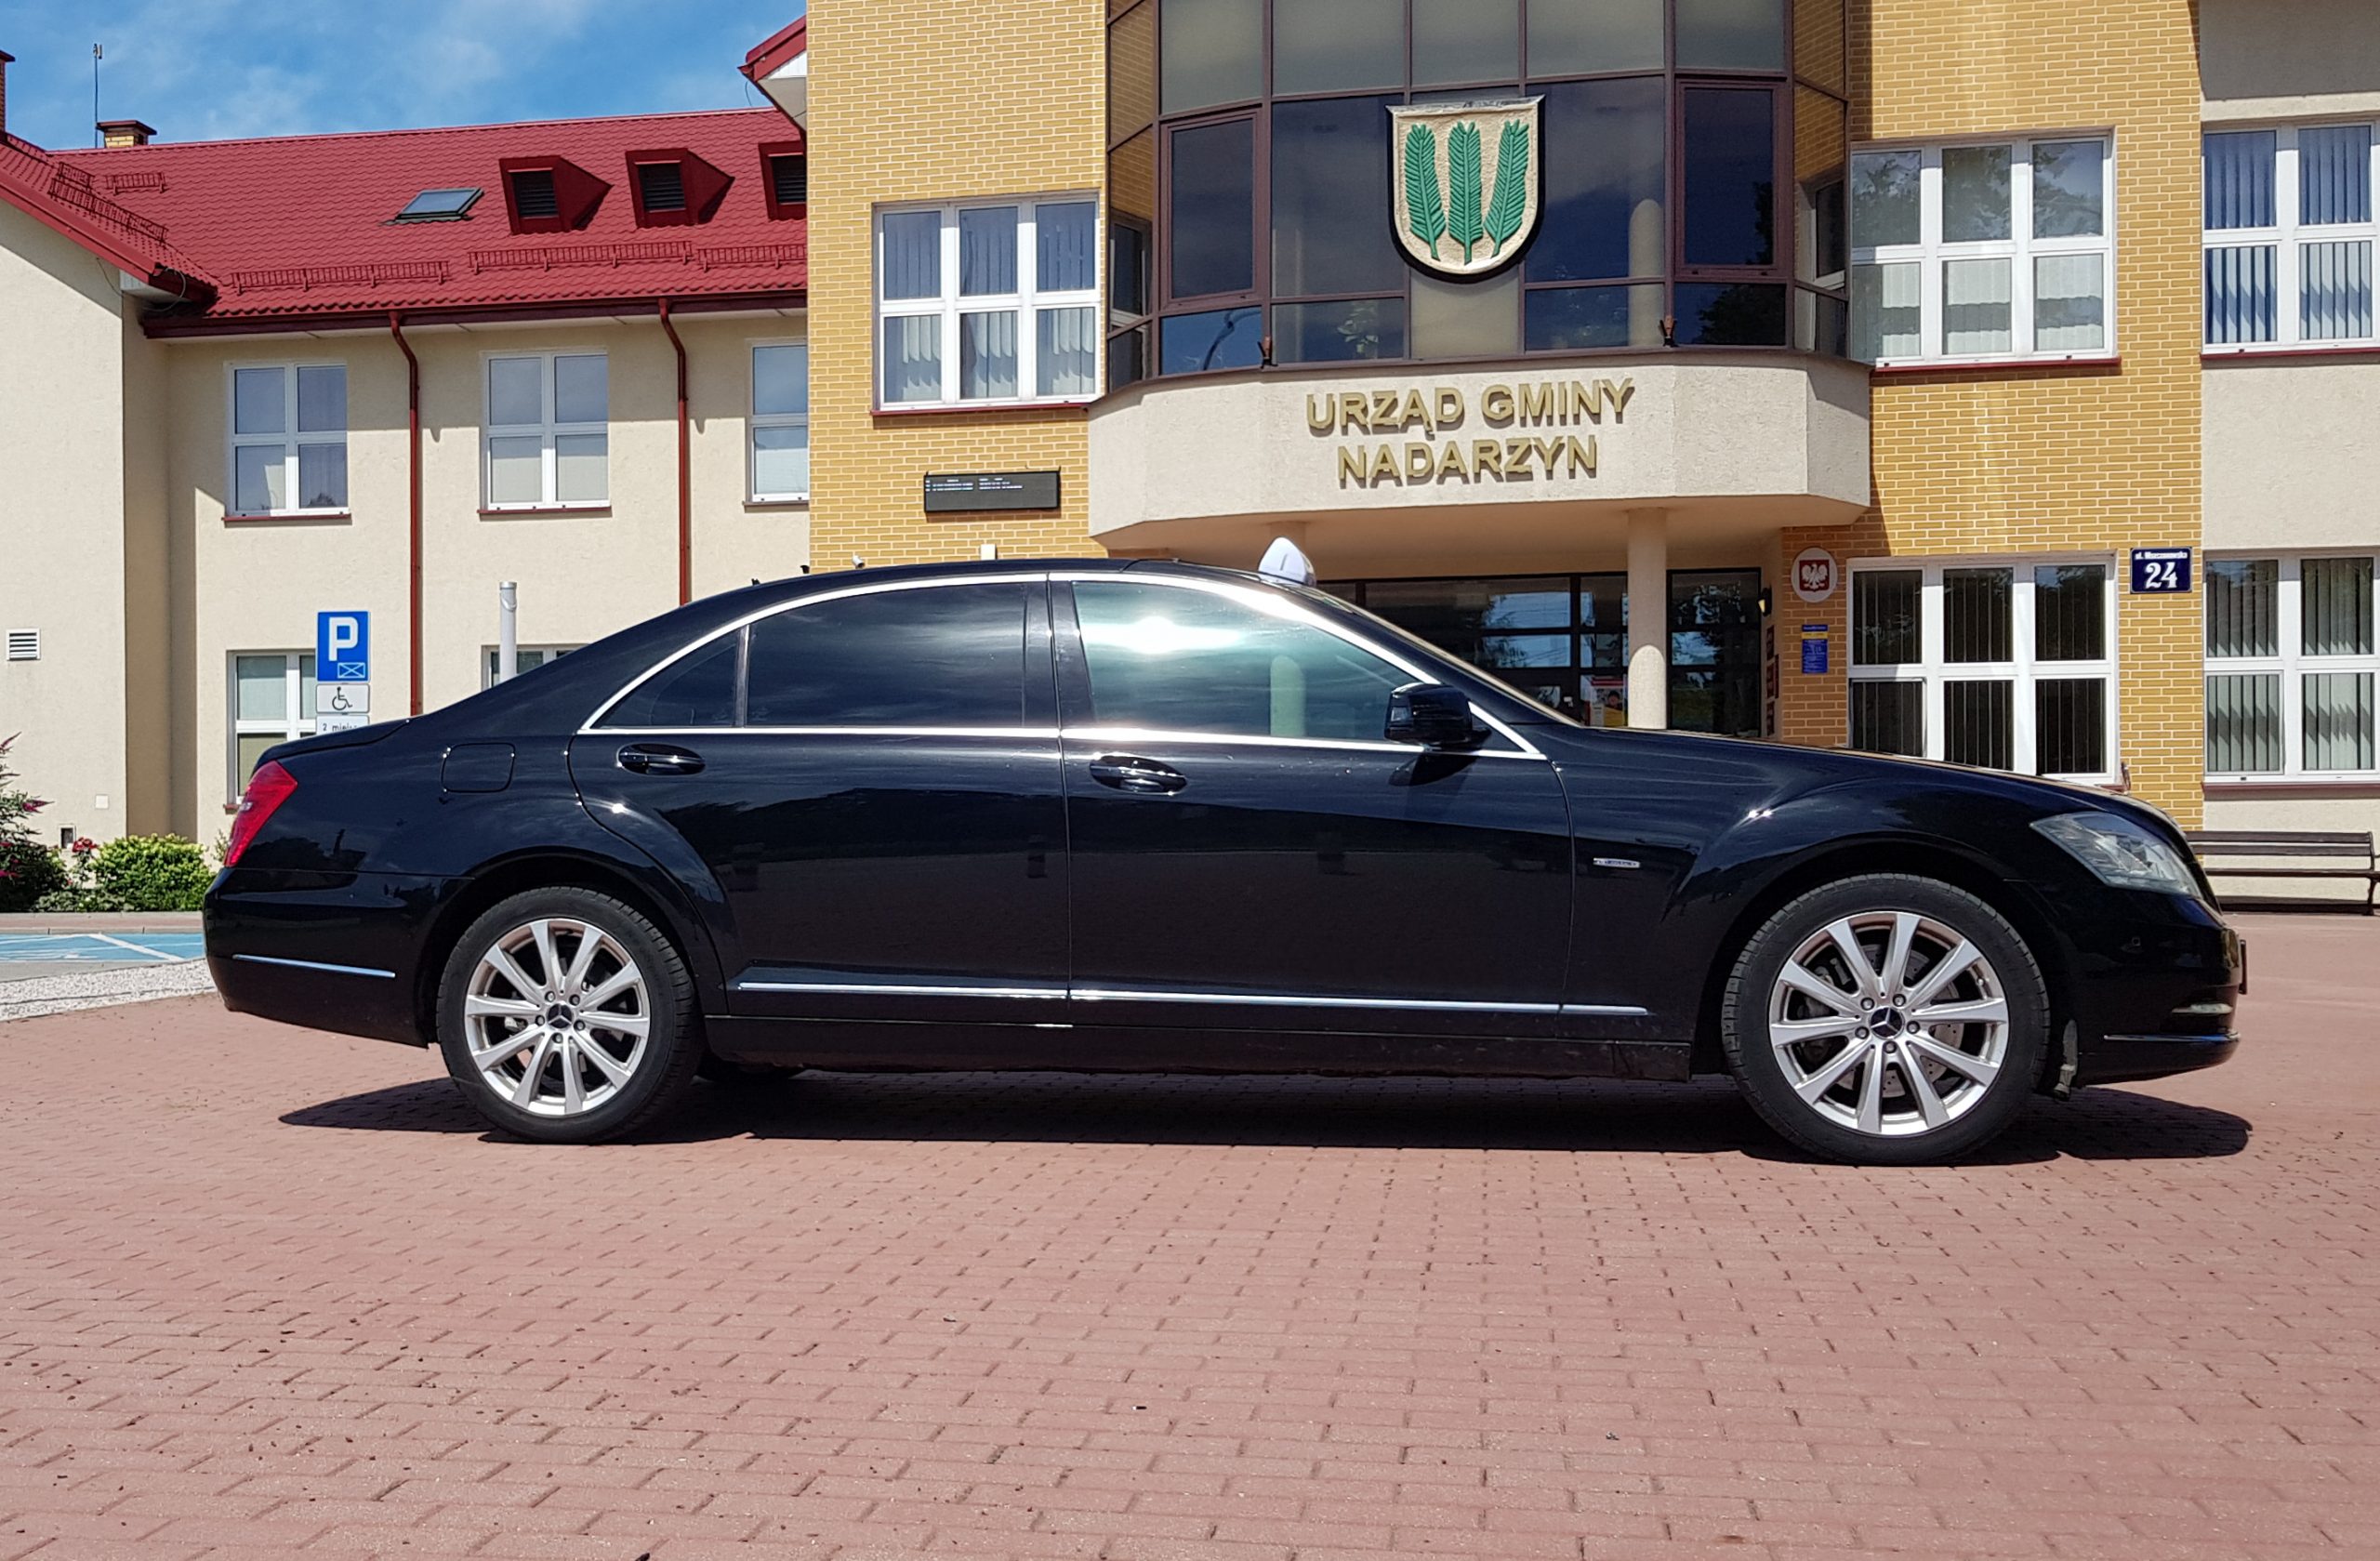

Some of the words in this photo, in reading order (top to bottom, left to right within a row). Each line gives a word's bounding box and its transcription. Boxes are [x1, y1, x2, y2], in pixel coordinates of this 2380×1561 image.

[1306, 387, 1464, 434] URZĄD
[1481, 377, 1633, 422] GMINY
[1338, 435, 1596, 482] NADARZYN
[2145, 562, 2177, 589] 24
[329, 616, 358, 661] P
